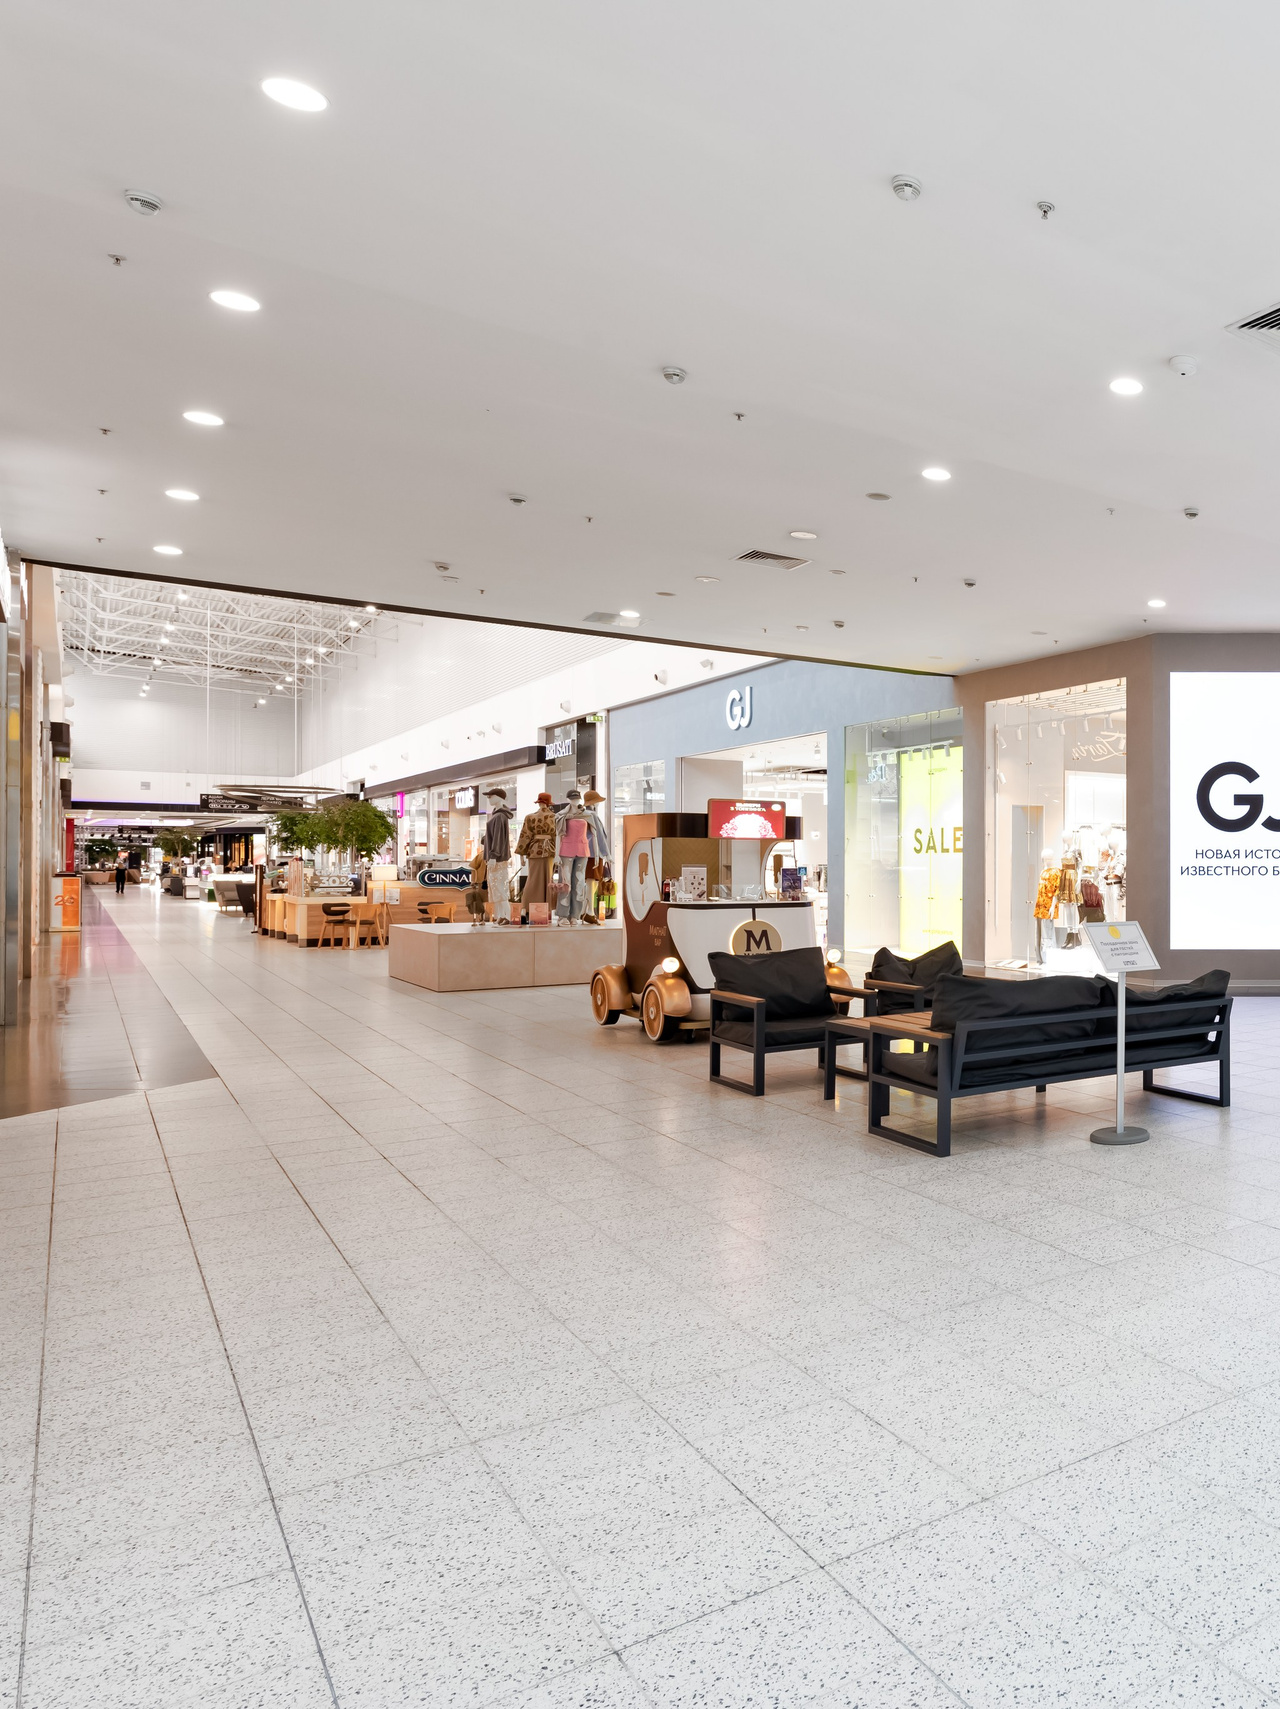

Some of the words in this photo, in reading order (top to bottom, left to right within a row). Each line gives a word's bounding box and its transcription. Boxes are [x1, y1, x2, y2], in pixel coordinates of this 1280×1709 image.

[726, 686, 753, 730] GJ
[913, 827, 963, 854] SALE
[1195, 849, 1241, 859] НОВАЯ
[1180, 866, 1269, 876] ИЗВЕСТНОГО
[744, 929, 772, 952] M
